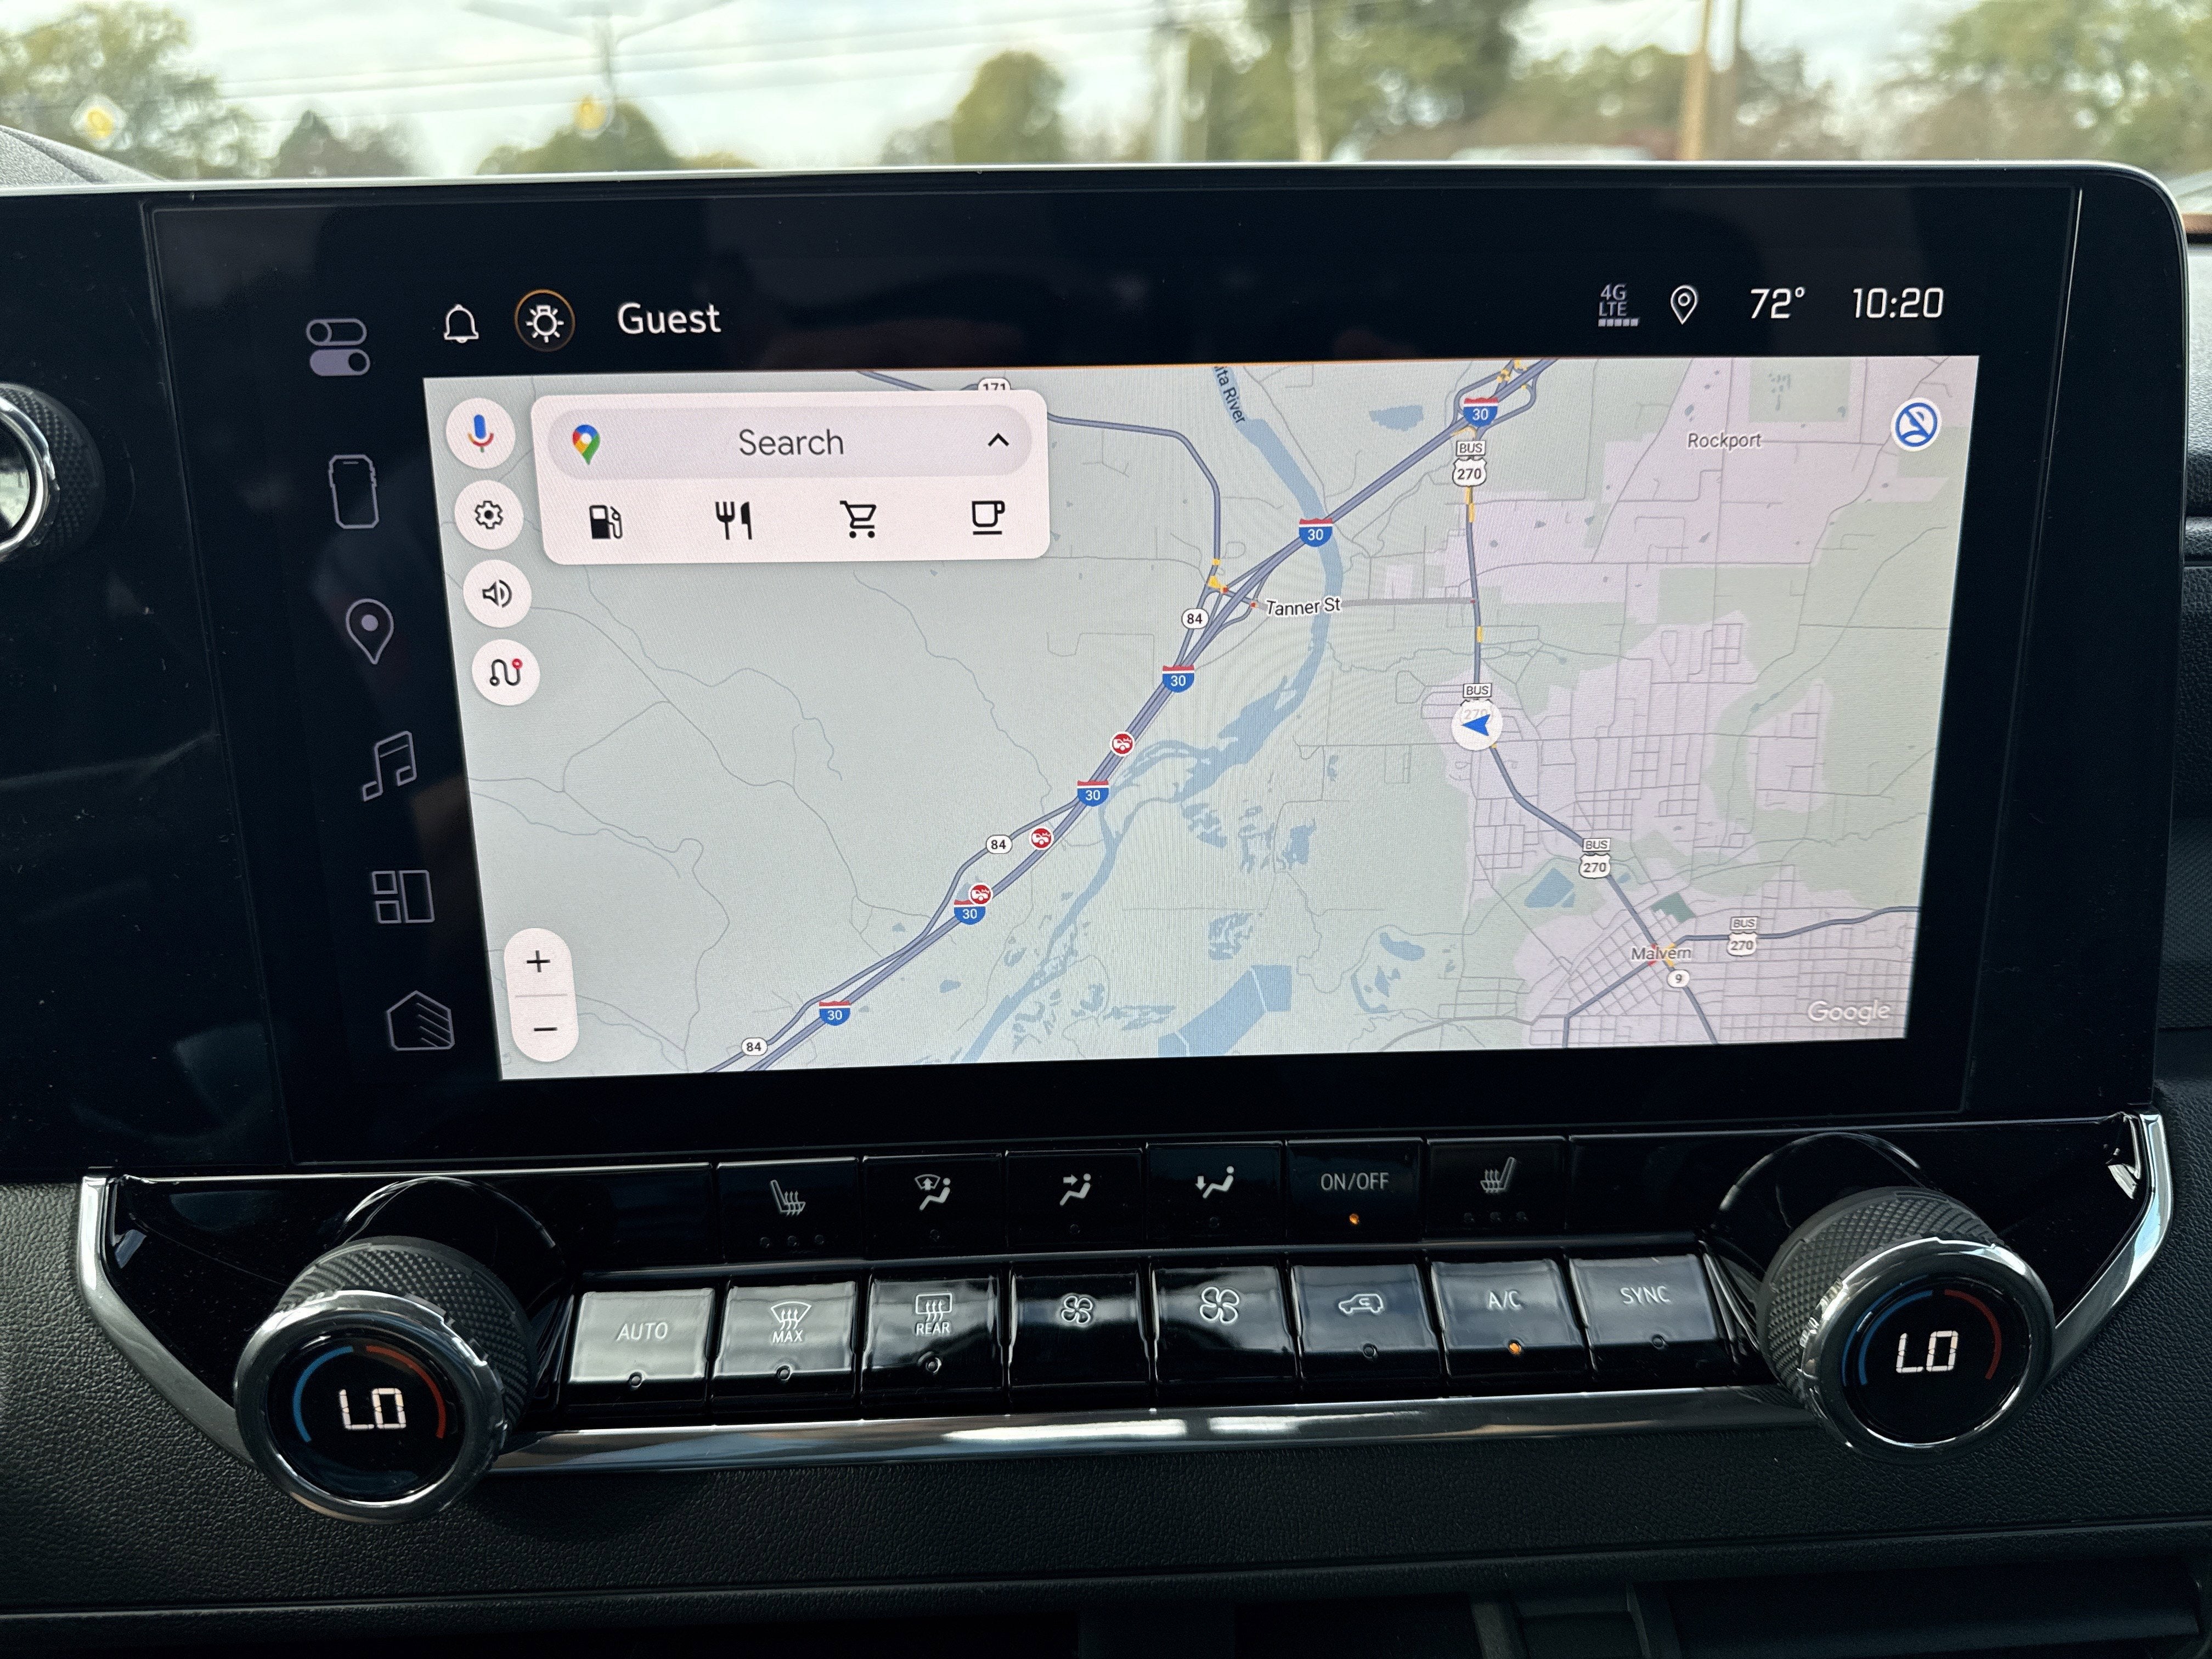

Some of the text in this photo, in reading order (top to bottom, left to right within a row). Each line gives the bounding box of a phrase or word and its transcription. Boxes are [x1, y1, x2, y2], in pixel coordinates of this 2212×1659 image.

[1600, 284, 1626, 301] 4G
[1599, 301, 1627, 317] LTE
[1751, 286, 1805, 319] 72°
[1853, 287, 1944, 318] 10:20
[618, 302, 721, 334] Guest
[1223, 387, 1245, 423] River
[1472, 408, 1489, 421] 30
[739, 428, 844, 456] Search
[1459, 443, 1483, 454] BUS
[1688, 432, 1762, 451] Rockport
[1457, 468, 1482, 480] 270
[1307, 528, 1324, 541] 30
[1266, 597, 1340, 616] Tanner St
[1187, 613, 1203, 625] 84
[1170, 675, 1186, 687] 30
[1466, 685, 1489, 696] BUS
[1085, 789, 1101, 801] 30
[991, 839, 1006, 850] 84
[1585, 840, 1609, 850] BUS
[1583, 862, 1606, 873] 270
[962, 909, 978, 920] 30
[1733, 918, 1756, 928] BUS
[1730, 940, 1754, 951] 270
[1632, 946, 1692, 961] Malvern
[1675, 974, 1683, 984] 9
[827, 1009, 843, 1021] 30
[1807, 1000, 1891, 1025] Google
[746, 1042, 761, 1052] 84
[1321, 1172, 1389, 1191] ON/OFF
[1487, 1290, 1521, 1310] A/C
[1620, 1285, 1671, 1305] SYNC
[616, 1322, 668, 1341] AUTO
[916, 1322, 951, 1335] REAR
[772, 1329, 803, 1344] MAX
[1895, 1330, 1959, 1373] LO
[339, 1387, 407, 1430] LO
